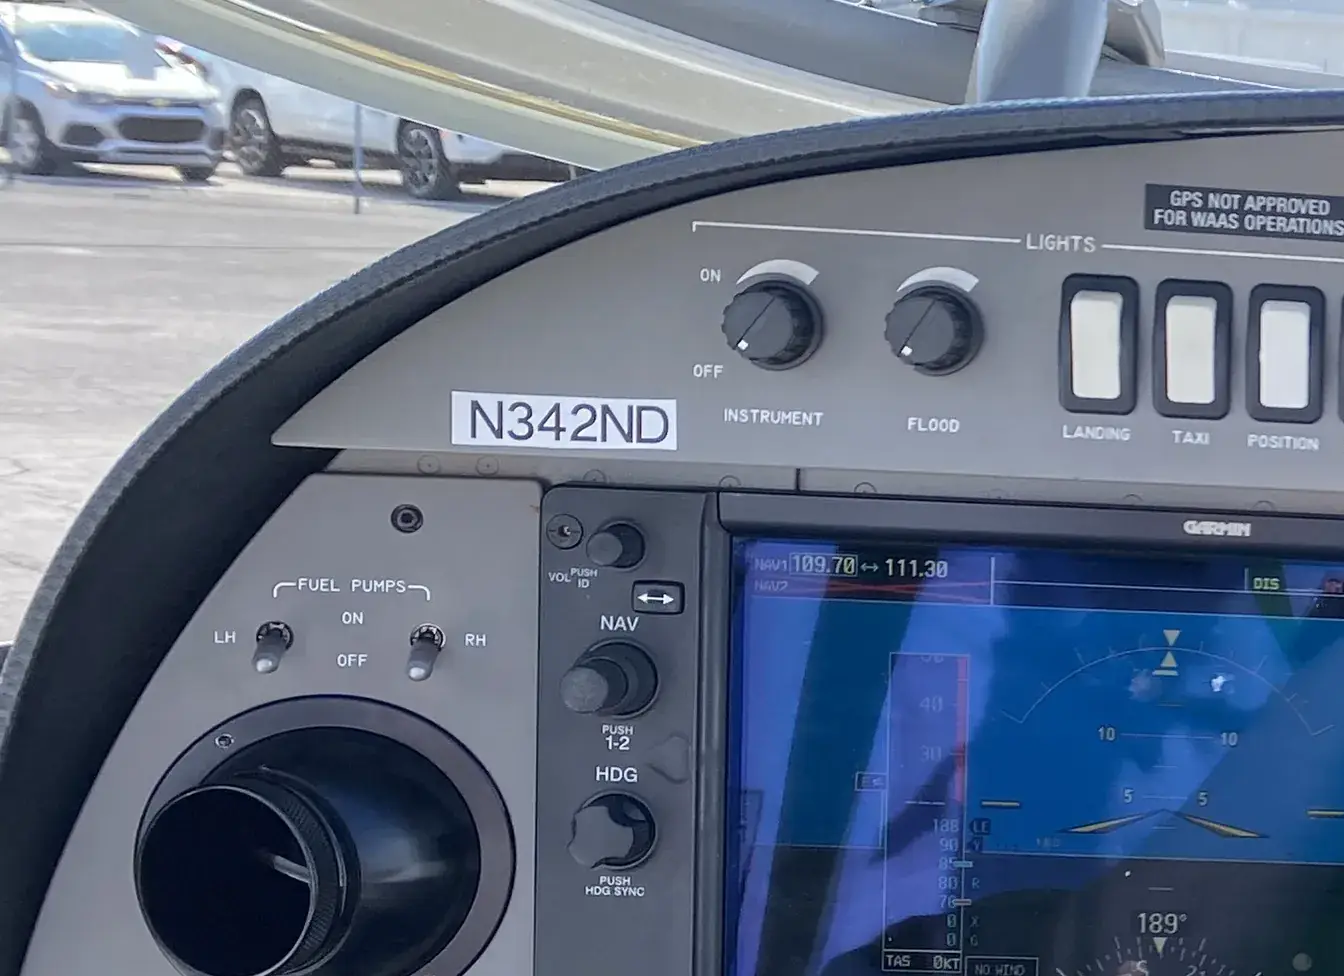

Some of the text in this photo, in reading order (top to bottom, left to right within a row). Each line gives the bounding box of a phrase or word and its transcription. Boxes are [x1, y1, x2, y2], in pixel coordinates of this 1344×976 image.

[1170, 190, 1331, 216] GPS NOT APPROVED
[1153, 208, 1188, 226] FOR
[1190, 210, 1240, 230] WAAS
[1026, 233, 1096, 253] LIGHTS
[700, 268, 721, 283] ON
[693, 363, 724, 379] OFF
[470, 399, 669, 444] N342ND
[724, 408, 824, 426] INSTRUMENT
[907, 416, 960, 433] FLOOD
[1062, 424, 1131, 441] LANDING
[1171, 429, 1210, 445] TAXI
[1247, 434, 1320, 451] POSITION
[1183, 520, 1252, 537] GARMIN
[298, 577, 406, 593] FUEL PUMPS
[341, 611, 364, 625] ON
[600, 614, 640, 632] NAV
[214, 630, 236, 644] LH
[465, 633, 486, 647] RH
[337, 653, 368, 667] OFF
[605, 734, 630, 751] 1-2
[595, 766, 638, 783] HDG
